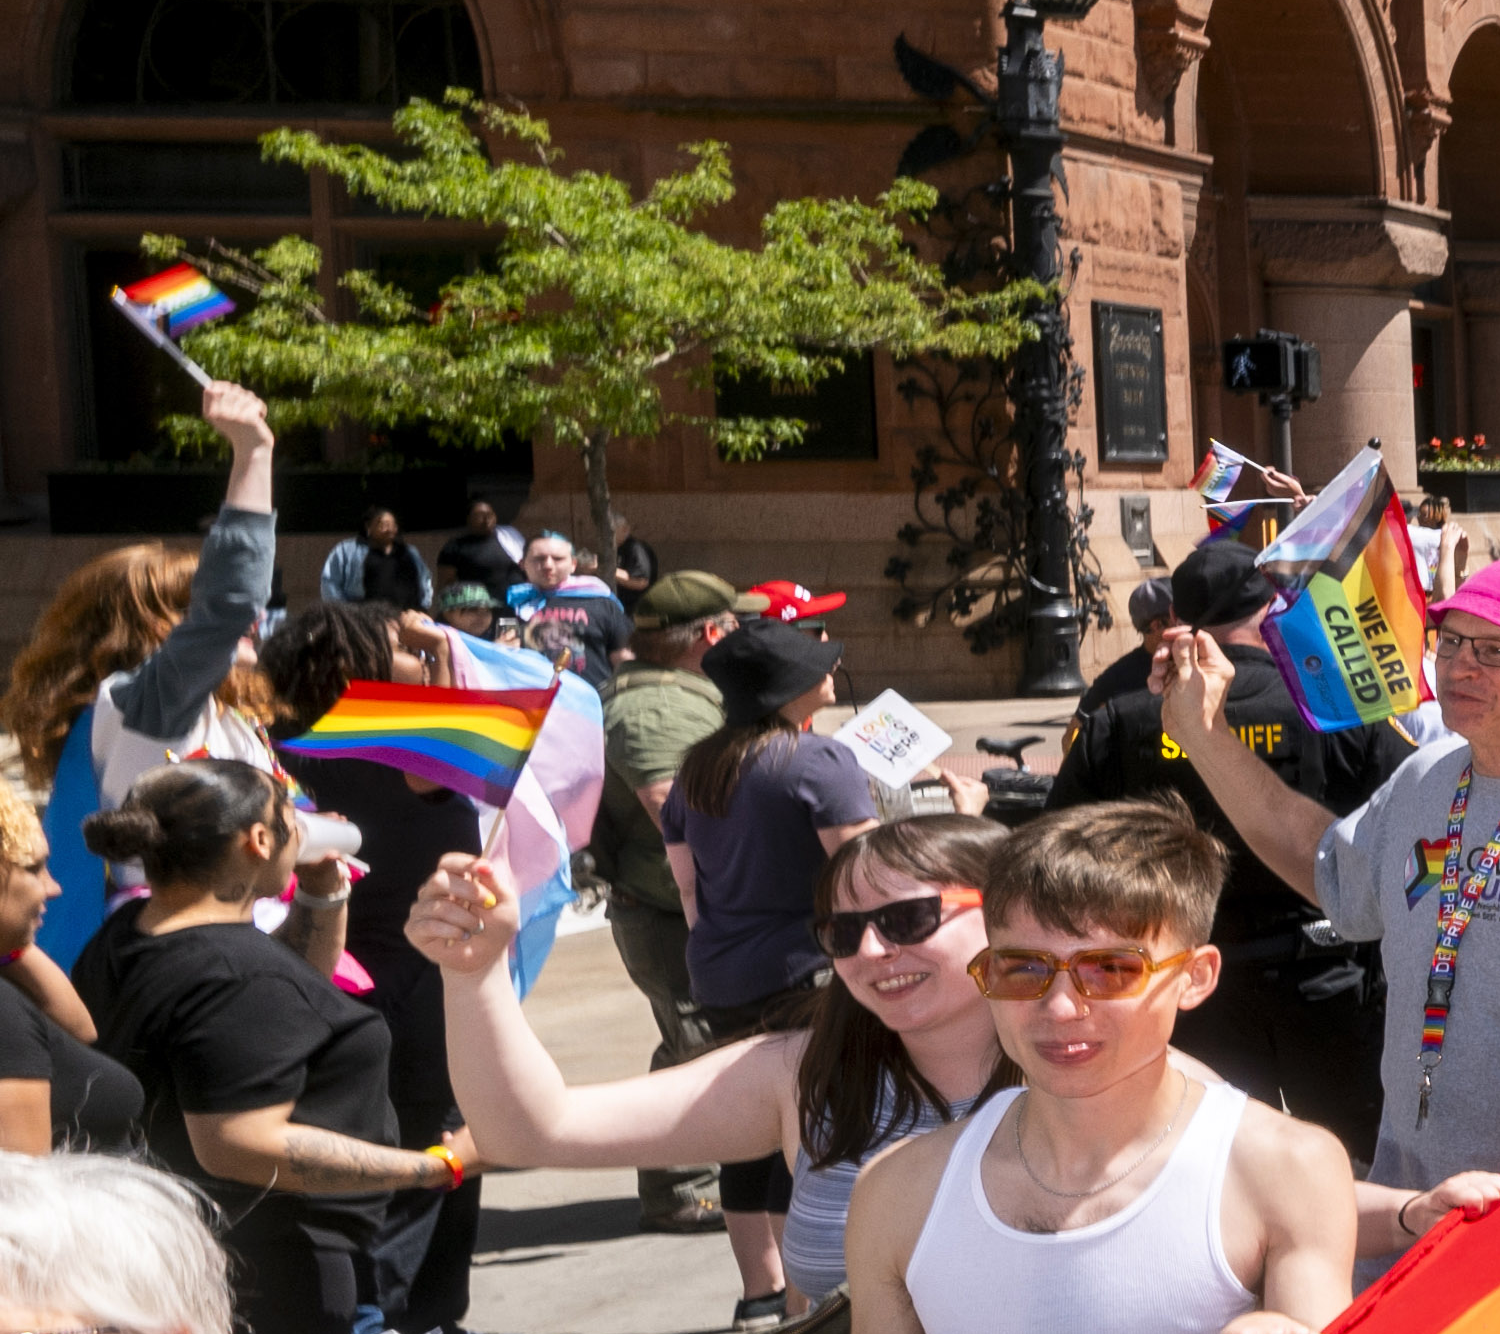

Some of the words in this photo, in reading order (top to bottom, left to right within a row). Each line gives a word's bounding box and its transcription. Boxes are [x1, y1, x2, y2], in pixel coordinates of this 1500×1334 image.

[1325, 605, 1382, 704] CALLED
[1355, 595, 1388, 641] WE
[1372, 643, 1412, 696] ARE
[1161, 725, 1282, 759] SIFF
[1448, 787, 1467, 834] PRIDE
[1445, 838, 1459, 887] PRIDE
[1468, 845, 1500, 895] PRIDE
[1443, 898, 1475, 948] PRIDE
